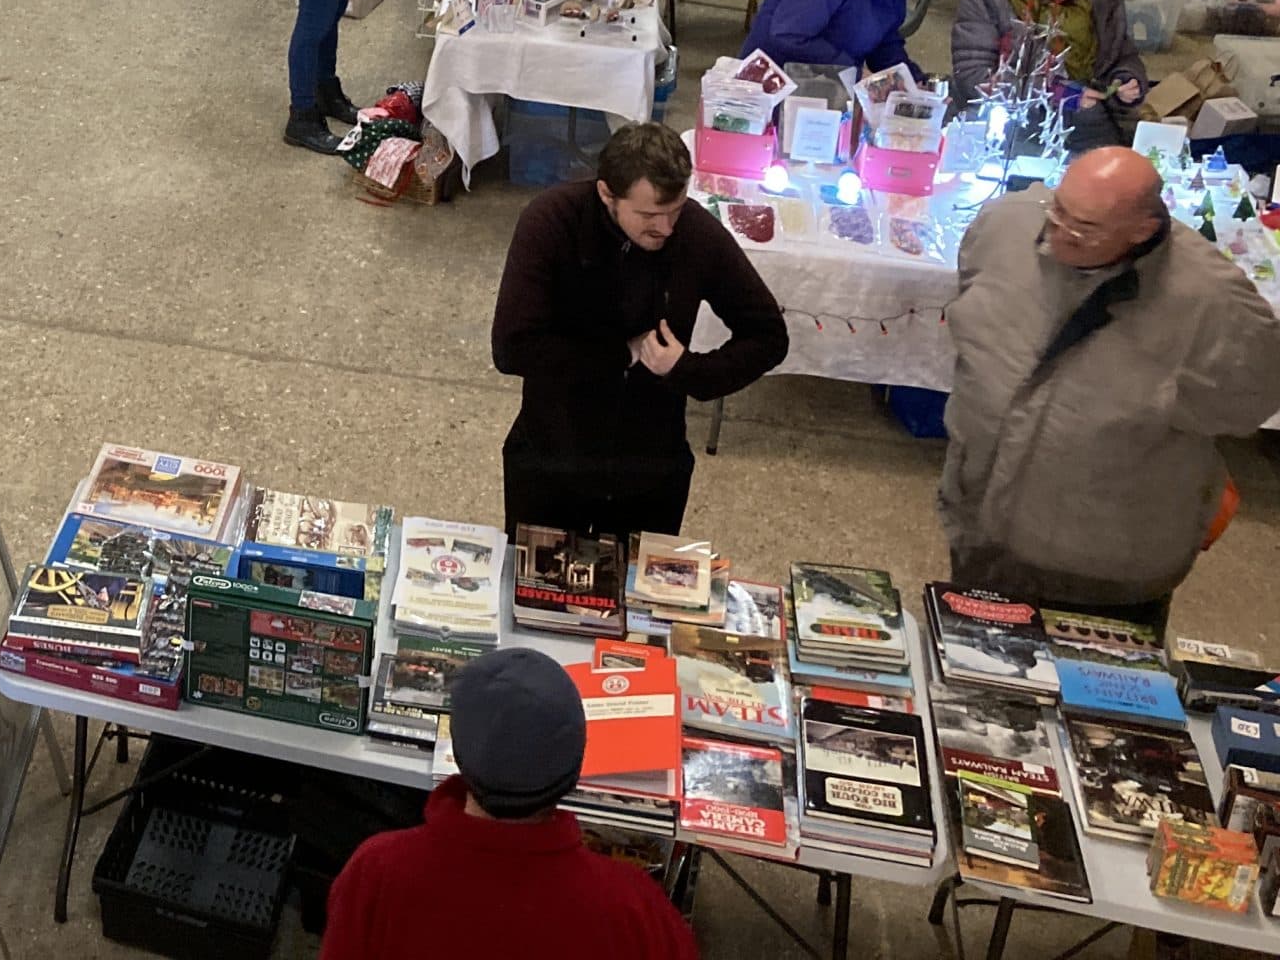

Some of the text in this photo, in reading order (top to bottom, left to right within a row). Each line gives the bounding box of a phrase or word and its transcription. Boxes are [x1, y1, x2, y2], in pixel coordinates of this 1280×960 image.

[194, 464, 226, 477] 1000
[564, 592, 616, 608] TICKETS
[33, 641, 72, 653] BUSES
[687, 695, 787, 727] STEAM
[950, 756, 1050, 782] STEAM RAILWAYS
[830, 784, 879, 798] COLOUR
[831, 791, 897, 809] BIG FOUR
[700, 809, 765, 827] CAMERA
[713, 819, 766, 836] STEAM
